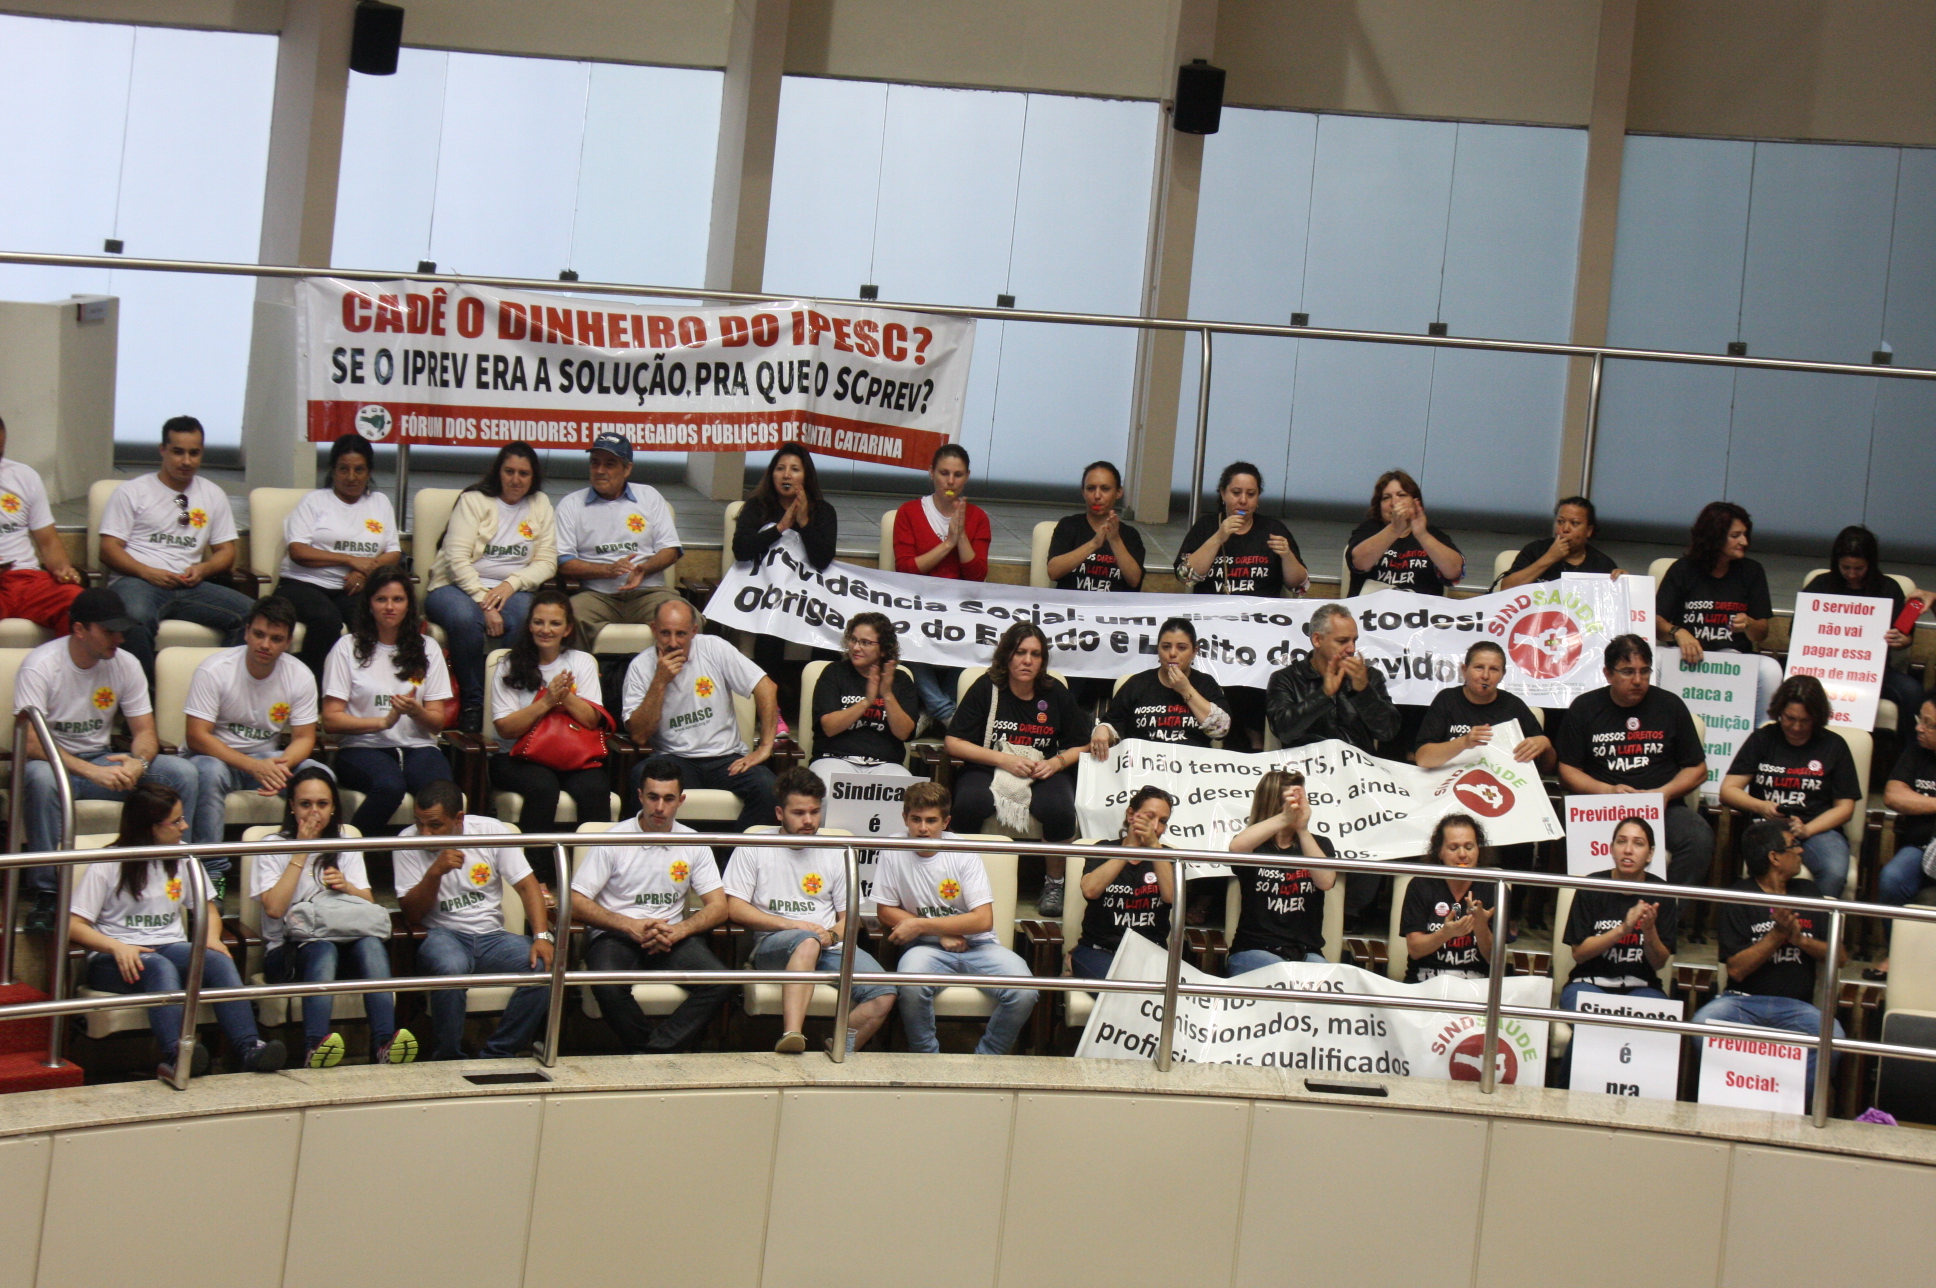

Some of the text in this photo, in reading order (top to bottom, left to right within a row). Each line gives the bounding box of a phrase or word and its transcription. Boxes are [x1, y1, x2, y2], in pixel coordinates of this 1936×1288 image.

[342, 287, 933, 365] CADÊ O DINHEIRO DO IPESC?
[332, 347, 364, 385] SE
[374, 348, 394, 386] O
[403, 349, 468, 388] IPREV
[476, 354, 528, 392] ERA
[534, 356, 552, 392] A
[756, 360, 810, 404] QUE
[814, 362, 829, 398] O
[833, 366, 934, 414] SCPREV?
[401, 414, 442, 438] FÓRUM
[446, 417, 476, 440] DOS
[480, 419, 578, 444] SERVIDORES
[581, 422, 590, 442] E
[593, 422, 697, 444] EMPREGADOS
[702, 420, 778, 444] PÚBLICOS
[782, 421, 798, 442] DE
[834, 428, 902, 459] CATARINA
[150, 533, 198, 548] APRASC
[334, 540, 379, 553] APRASC
[595, 542, 638, 555] APRASC
[484, 544, 528, 558] APRASC
[1236, 555, 1269, 564] DIREITOS
[1410, 559, 1428, 569] FAZ
[1079, 563, 1122, 580] A LUTA FA
[1250, 566, 1269, 578] FAZ
[1377, 570, 1415, 584] VALER
[1076, 576, 1112, 592] VALER
[1214, 580, 1254, 592] VALER
[1715, 601, 1748, 611] DIREITOS
[1812, 599, 1876, 616] O servidor
[1095, 616, 1156, 626] um
[1360, 609, 1483, 632] todos!
[1683, 611, 1696, 624] SÓ
[1697, 612, 1704, 624] A
[1705, 613, 1729, 624] LUTA
[1818, 622, 1862, 638] não vai
[921, 619, 966, 642] do
[1266, 640, 1309, 667] do
[1802, 644, 1872, 661] pagar essa
[1790, 665, 1878, 683] conta de mais
[1682, 686, 1733, 702] ataca a
[670, 706, 714, 728] APRASC
[1134, 705, 1166, 714] NOSSOS
[54, 718, 104, 732] APRASC
[992, 720, 1054, 735] OSSOS DIREITOS
[1136, 714, 1147, 728] SÓ
[1149, 716, 1156, 728] A
[1158, 716, 1181, 727] LUTA
[1450, 724, 1471, 734] NOSS
[1008, 734, 1032, 746] LUTA
[1032, 738, 1052, 748] FAZ
[1148, 729, 1188, 742] VALER
[1592, 730, 1664, 742] NOSSOS DIREITOS
[1593, 742, 1664, 757] SÓ A LUTA FAZ
[1115, 750, 1134, 774] Já
[1142, 752, 1183, 774] não
[1188, 759, 1263, 776] temos
[1606, 756, 1650, 772] VALER
[1434, 756, 1528, 796] SINDSAÚDE
[1766, 776, 1774, 788] A
[1774, 777, 1801, 789] LUTA
[1802, 778, 1822, 791] FAZ
[832, 782, 906, 802] Sindica
[1348, 778, 1410, 799] ainda
[1764, 789, 1806, 807] VALER
[1570, 805, 1659, 822] Previdência
[868, 814, 881, 832] é
[1317, 821, 1330, 834] o
[1338, 809, 1409, 838] pouco
[1256, 878, 1270, 892] SÓ
[1271, 882, 1279, 895] A
[440, 891, 486, 912] APRASC
[634, 892, 680, 906] APRASC
[768, 898, 816, 913] APRASC
[1103, 895, 1114, 908] SÓ
[1116, 898, 1124, 910] A
[1126, 898, 1150, 910] LUTA
[1267, 896, 1305, 914] VALER
[125, 912, 176, 928] APRASC
[1114, 912, 1156, 927] VALER
[1436, 948, 1480, 966] VALER
[1328, 1014, 1387, 1037] mais
[1260, 1046, 1410, 1076] qualificados
[1619, 1042, 1632, 1064] é
[1725, 1070, 1780, 1093] Social:
